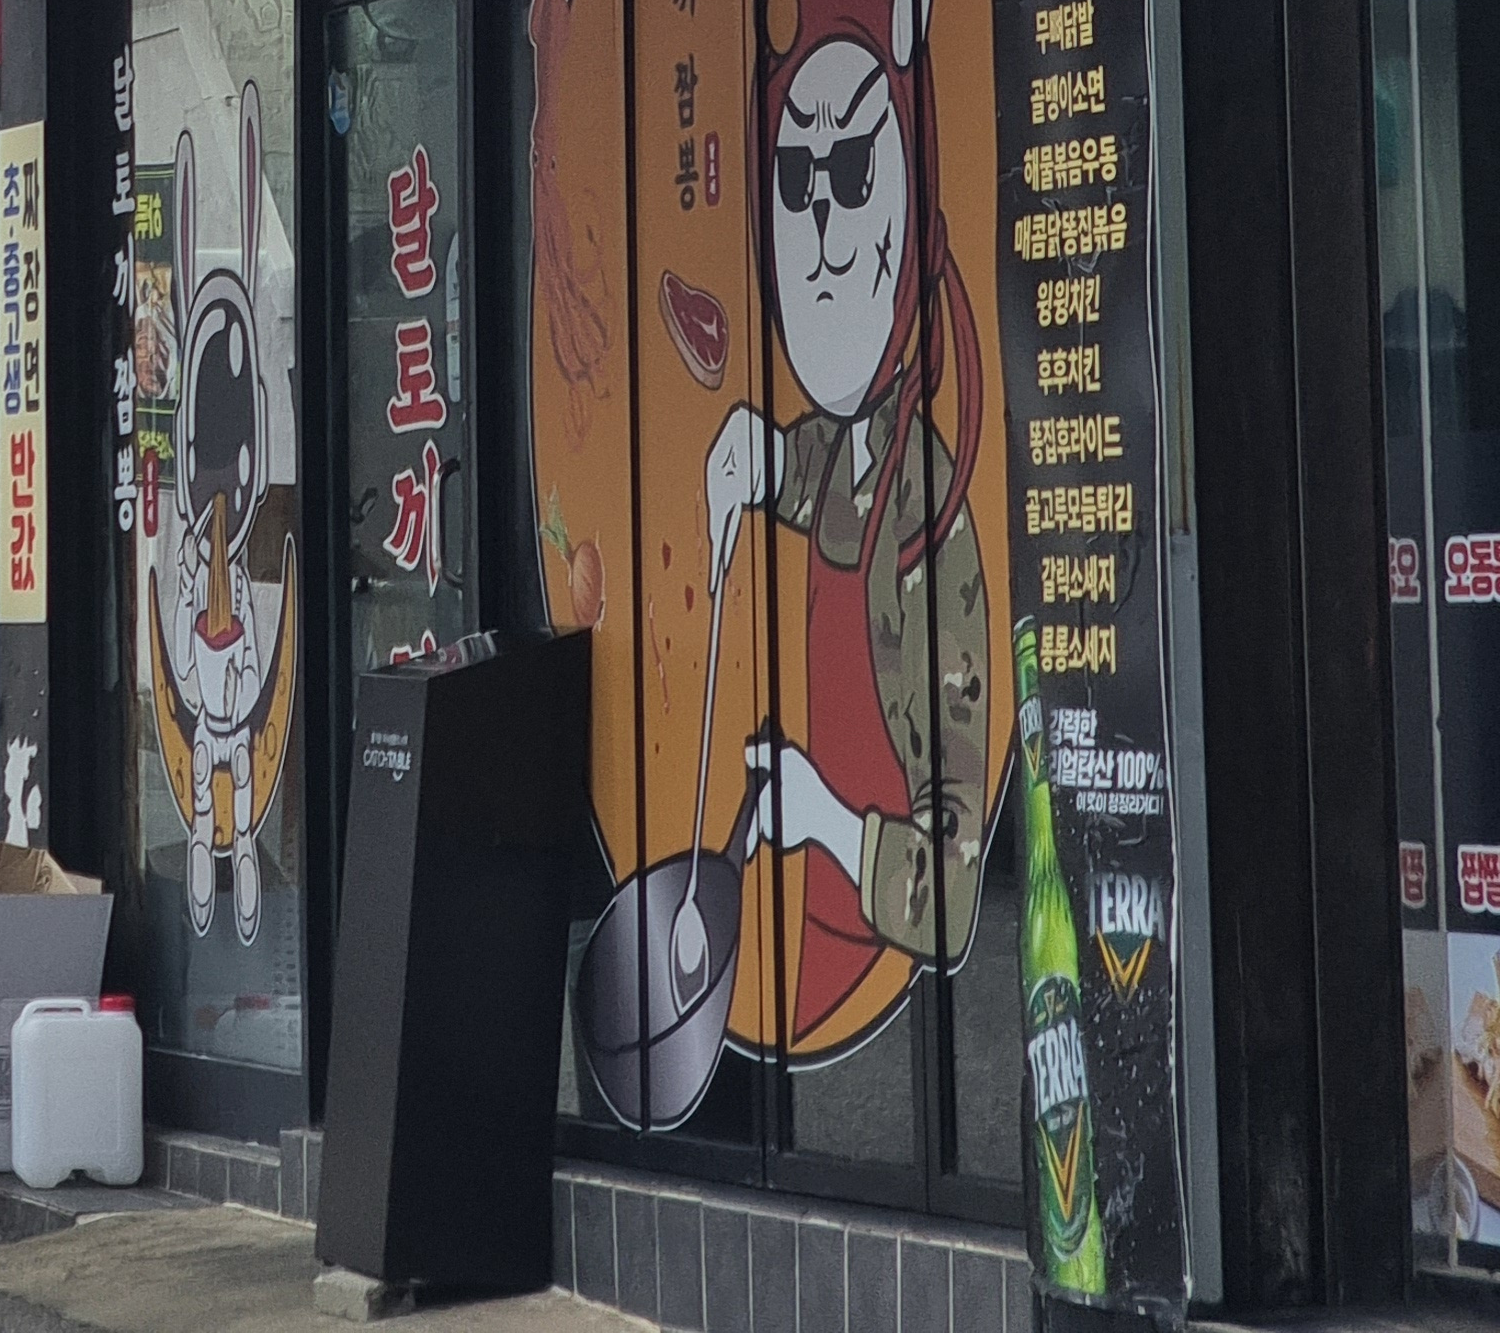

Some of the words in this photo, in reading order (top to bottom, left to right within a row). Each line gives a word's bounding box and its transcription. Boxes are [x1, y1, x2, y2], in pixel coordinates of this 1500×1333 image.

[1030, 65, 1106, 125] 골뱅이소면
[1023, 135, 1119, 192] 해물볶음우동
[1013, 202, 1128, 262] 매콤닭똥집볶음
[22, 158, 40, 414] 짜장면
[1036, 274, 1101, 328] 윙윙치킨
[1037, 343, 1101, 396] 후후치킨
[1029, 413, 1123, 466] 똥집후라이드
[10, 429, 35, 592] 반값
[1025, 482, 1132, 534] 골고루모듬튀김
[1041, 554, 1116, 604] 갈릭소세지
[1040, 624, 1117, 676] 롱롱소세지
[1049, 708, 1097, 747] 강력한
[1117, 750, 1165, 791] 100%
[1088, 872, 1165, 941] TERRA
[1028, 1018, 1088, 1122] TERRA
